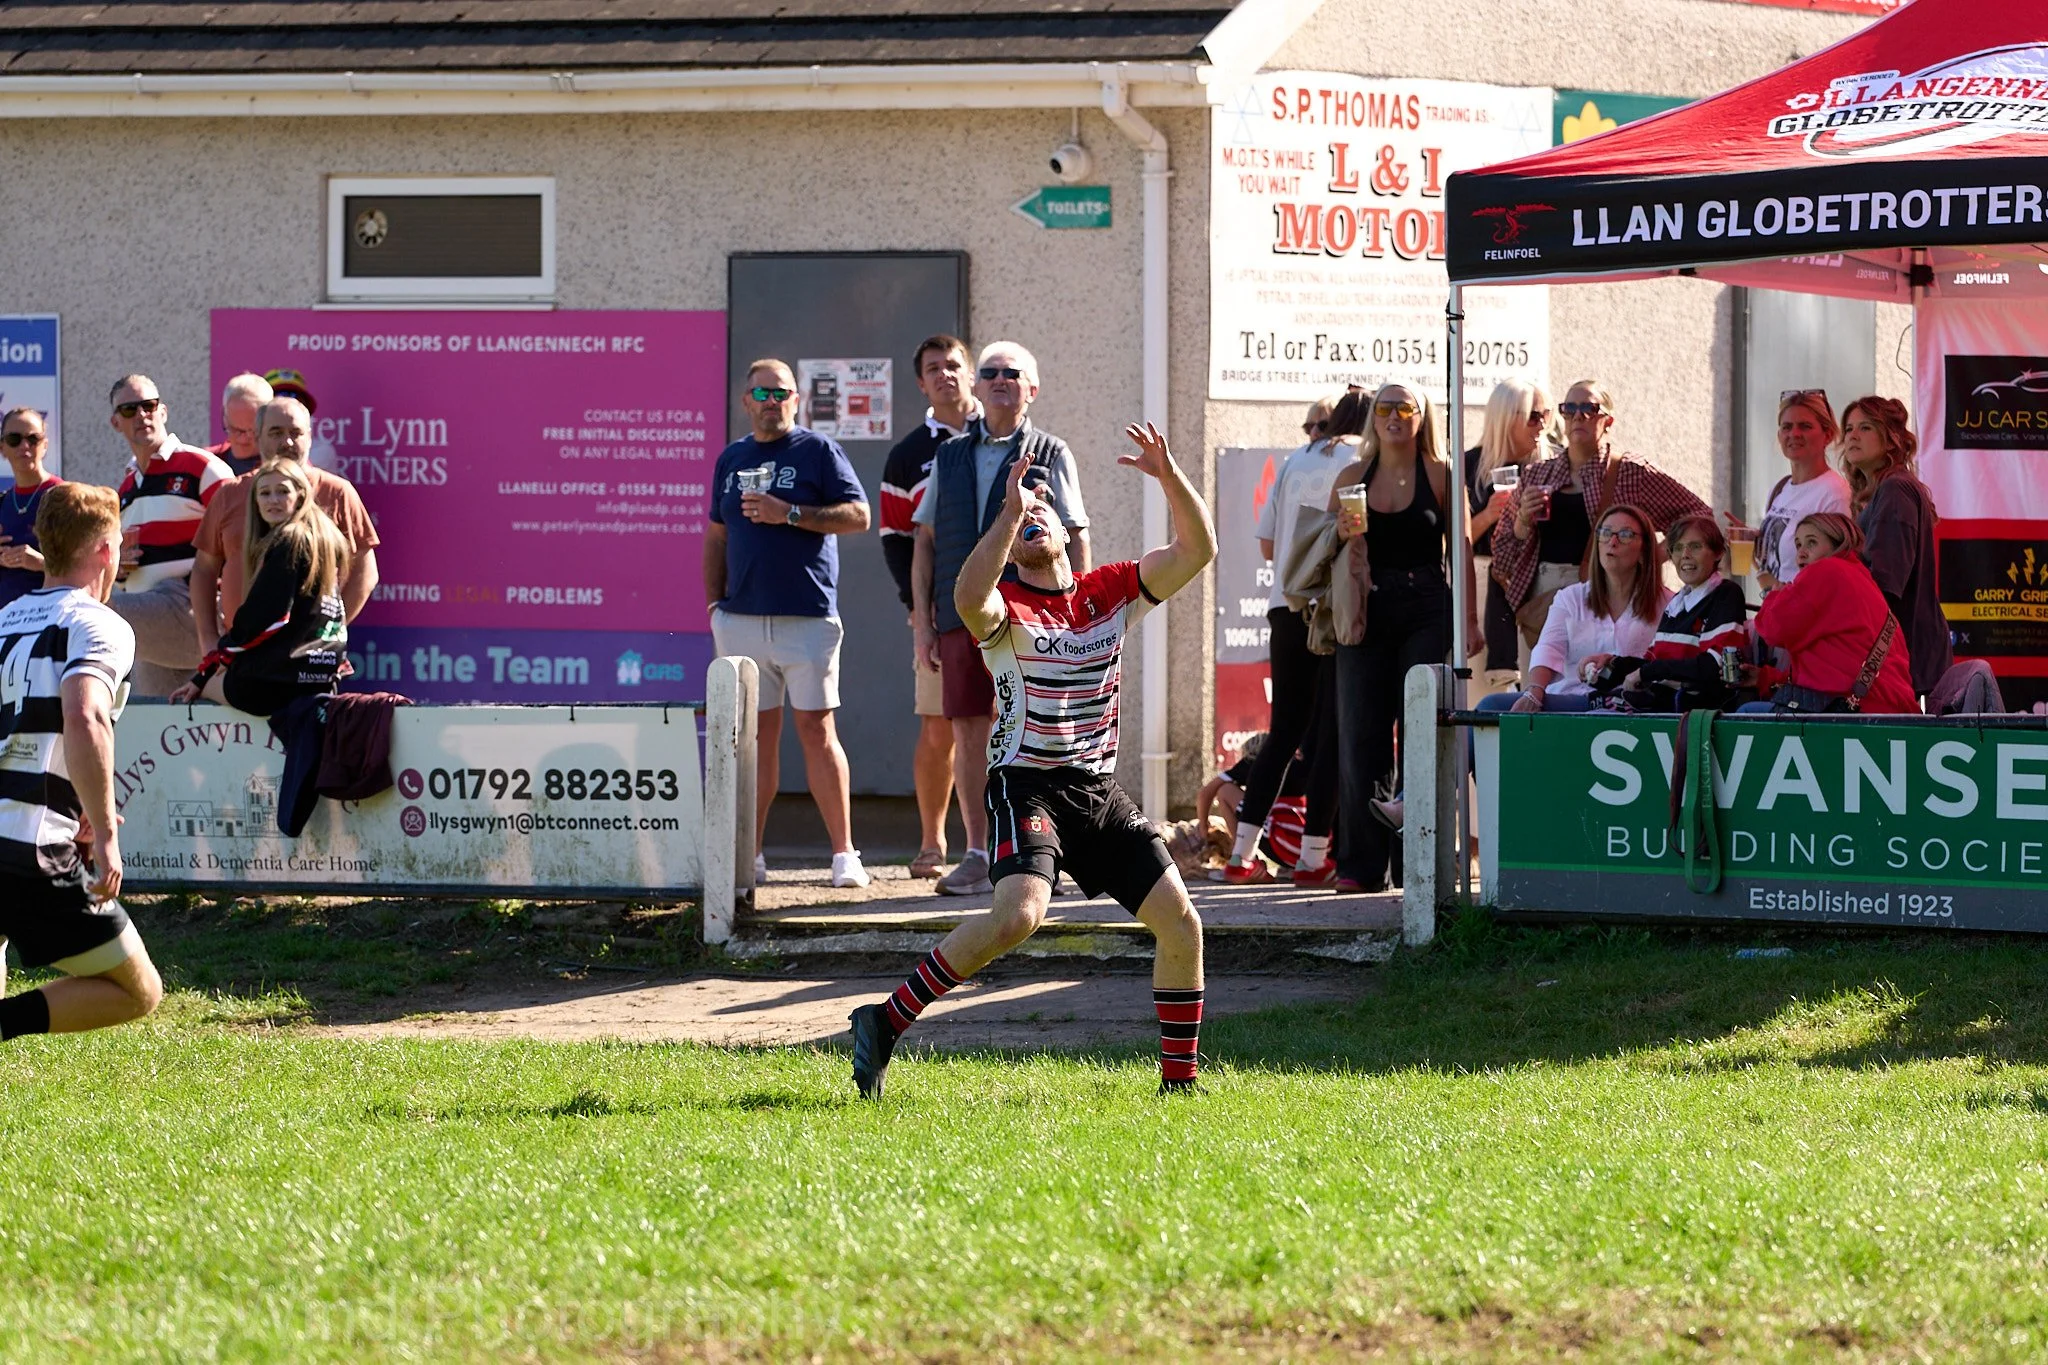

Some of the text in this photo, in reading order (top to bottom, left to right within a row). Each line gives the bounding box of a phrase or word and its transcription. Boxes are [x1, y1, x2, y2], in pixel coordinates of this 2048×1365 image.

[1273, 150, 1315, 171] WHILE
[1328, 143, 1359, 193] L
[1370, 144, 1410, 197] &
[1238, 174, 1300, 195] YOU WAIT
[1046, 201, 1103, 216] TOILETS
[1572, 202, 1684, 247] LLAN
[1484, 247, 1541, 261] FELINFOEL
[0, 337, 42, 363] ion
[288, 334, 645, 353] PROUD SPONSORS OF LLANGENNECH RFC
[1240, 331, 1530, 367] Tel or Fax: 01554 20765
[1221, 369, 1262, 383] BRIDGE
[583, 408, 705, 424] CONTACT US FOR A
[1956, 410, 1983, 429] JJ
[311, 406, 449, 455] ter Lynn
[542, 426, 705, 442] FREE INITIAL DISCUSSION
[559, 445, 705, 461] ON ANY LEGAL MATTER
[336, 455, 449, 486] RTNERS
[497, 481, 557, 495] LLANELLI
[560, 481, 606, 496] OFFICE
[511, 519, 704, 535] www.peterlynnandpartners.co.uk
[374, 583, 441, 603] ENTING
[506, 586, 604, 606] PROBLEMS
[1974, 588, 2015, 602] GARRY
[1972, 606, 2033, 617] ELECTRICAL
[1034, 631, 1118, 656] CK foodstores
[346, 641, 685, 685] oin the Team GRS
[1002, 670, 1016, 749] ADVERTISING
[160, 721, 253, 758] Gwyn
[428, 767, 680, 801] 01792 882353
[429, 812, 680, 836] llysgwyn1@btconnect.com
[122, 853, 379, 873] sidential & Dementia Care Home
[1748, 887, 1954, 918] Established 1923
